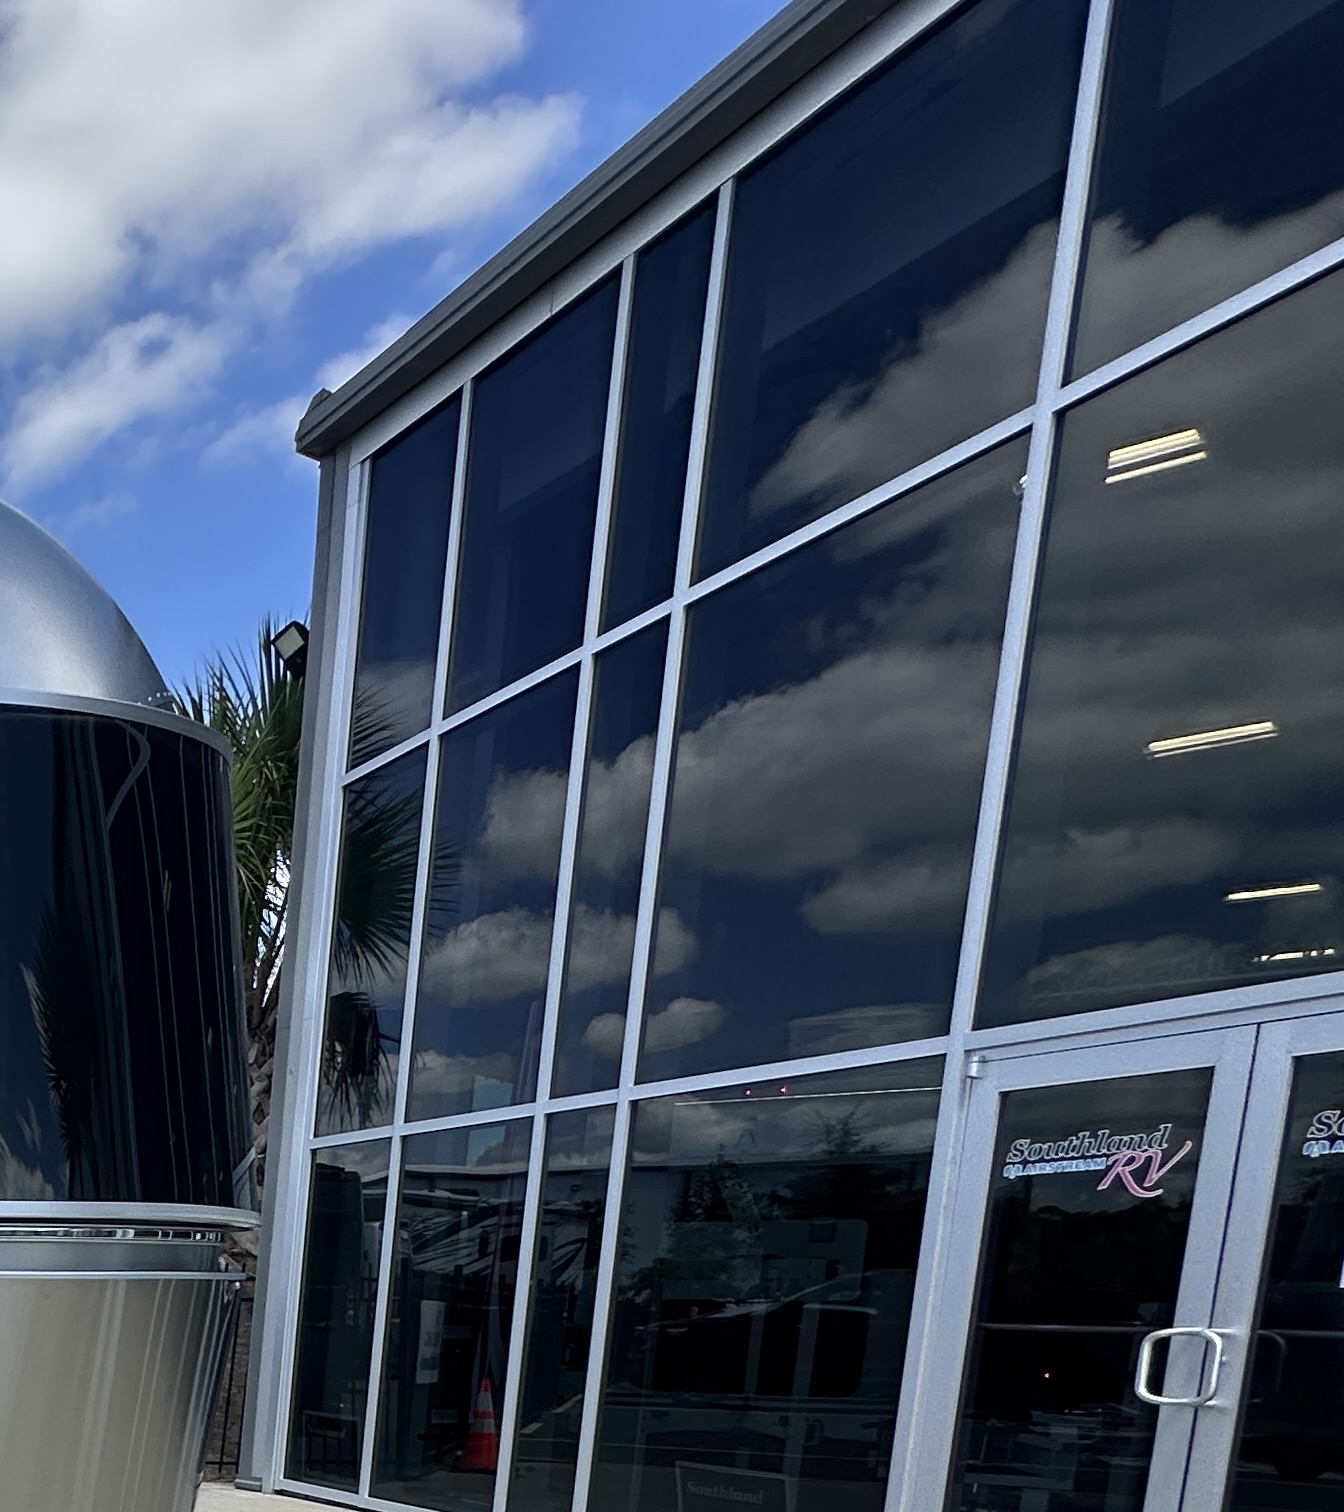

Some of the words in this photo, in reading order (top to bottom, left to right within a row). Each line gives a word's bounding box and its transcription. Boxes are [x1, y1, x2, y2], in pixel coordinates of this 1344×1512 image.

[1005, 1123, 1173, 1163] Southland
[1021, 1156, 1107, 1176] AIRSTREAM
[1096, 1140, 1193, 1198] RV
[687, 1481, 765, 1505] Southland
